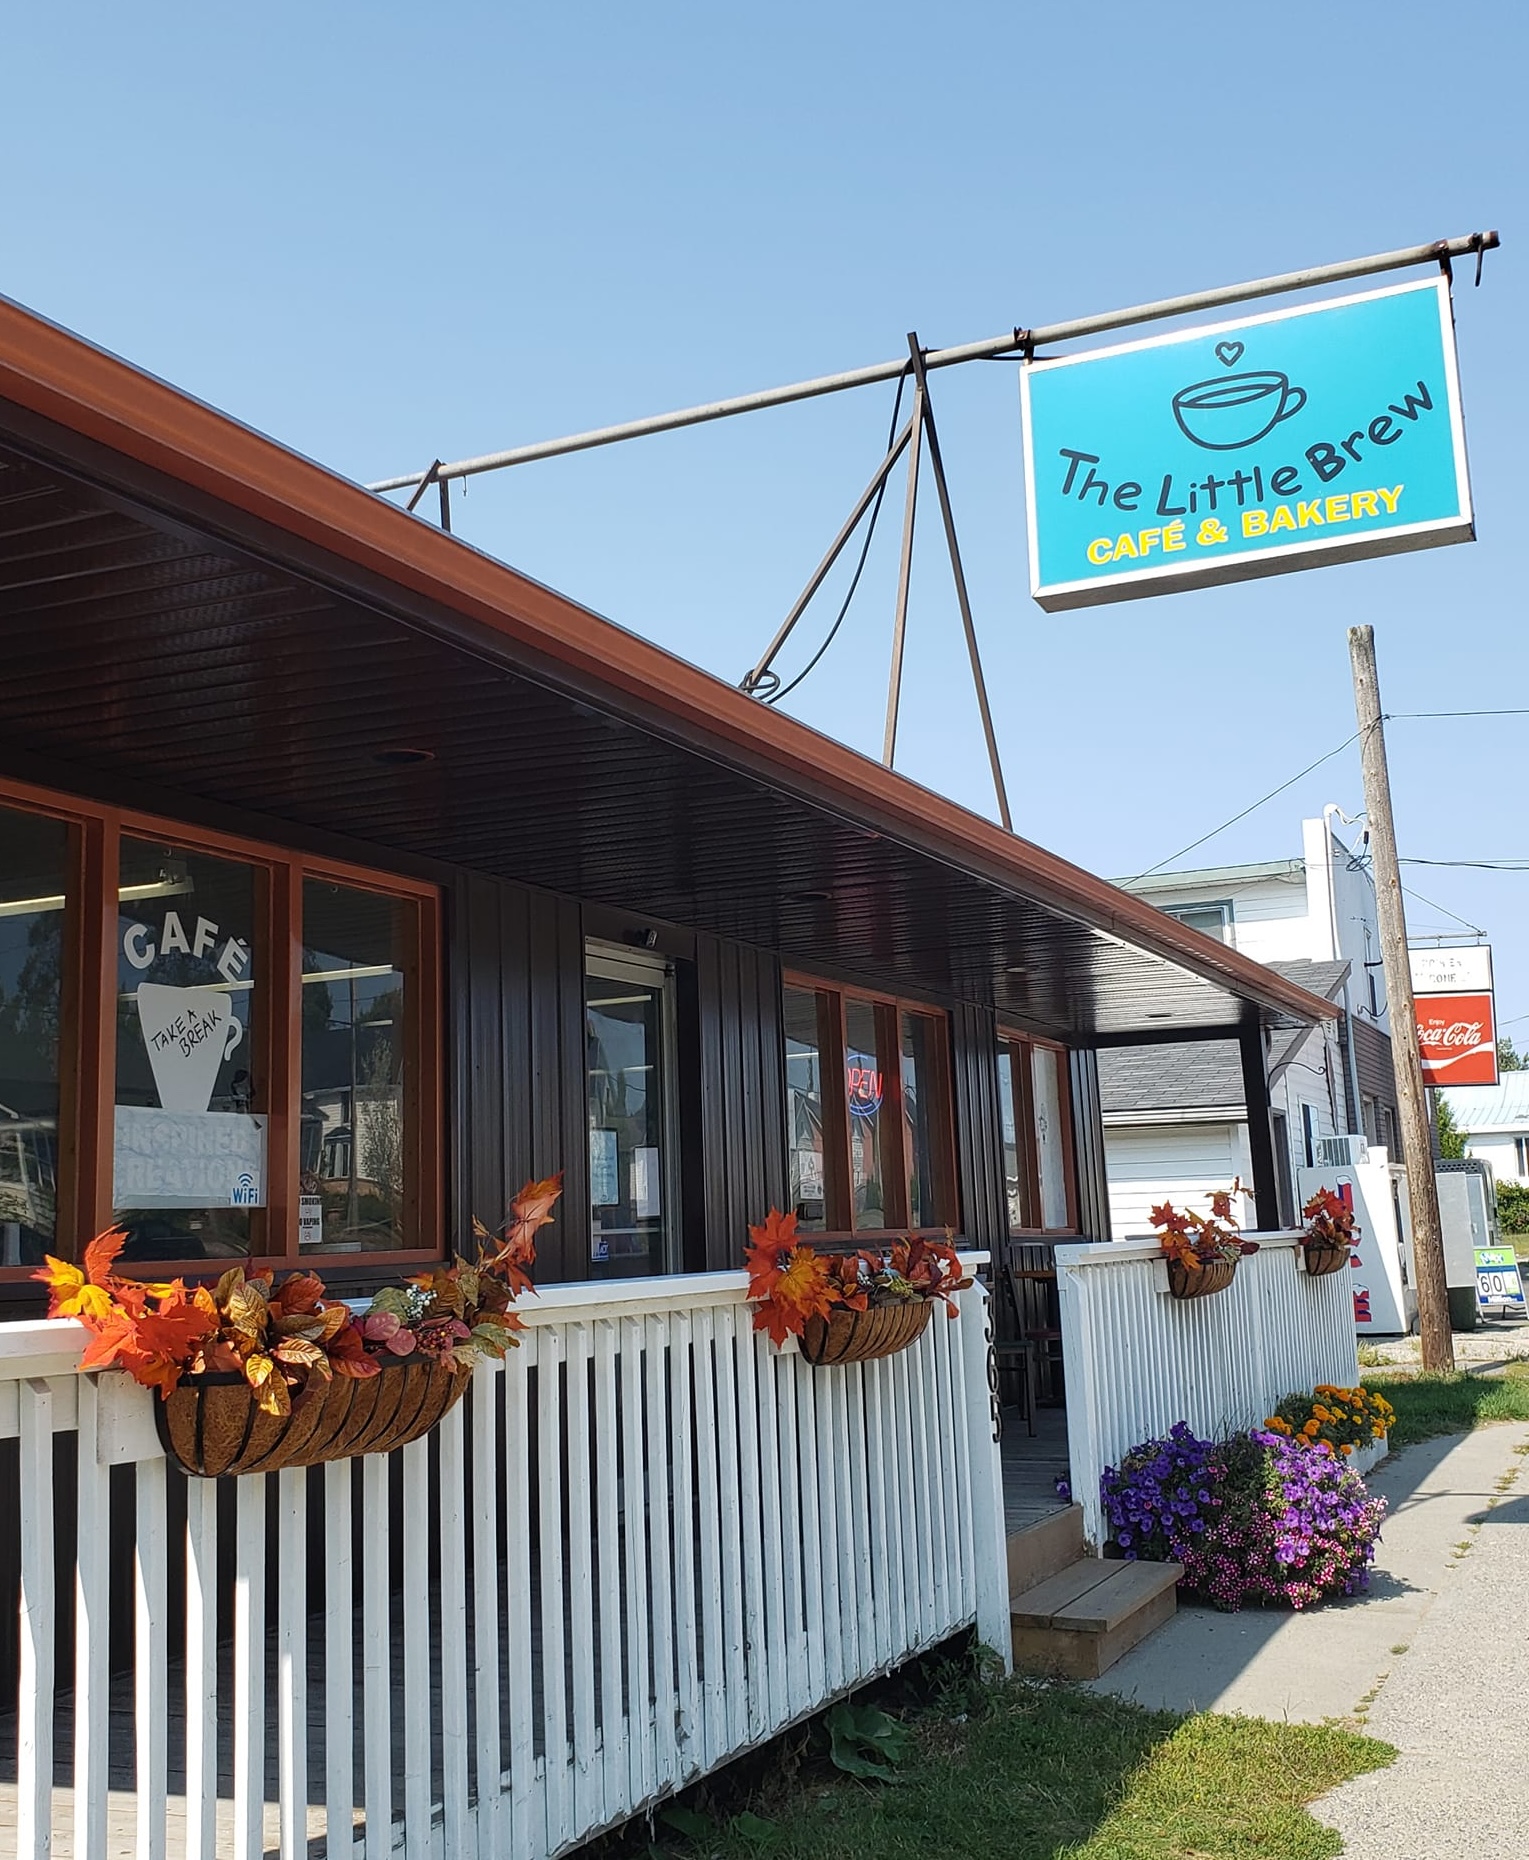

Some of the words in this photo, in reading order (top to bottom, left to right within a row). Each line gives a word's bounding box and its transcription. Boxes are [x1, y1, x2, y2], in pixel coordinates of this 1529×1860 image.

[1059, 448, 1142, 511] The
[1156, 466, 1303, 516] Little
[1305, 380, 1434, 482] Brew
[1087, 518, 1187, 566] CAFÉ
[1196, 516, 1229, 547] &
[1241, 484, 1406, 540] BAKERY
[123, 911, 249, 983] CAFÉ
[151, 1016, 187, 1051] TAKE
[187, 1009, 198, 1023] A
[179, 1009, 222, 1058] BREAK
[1416, 1021, 1484, 1046] oca-Cola
[232, 1187, 258, 1204] WiFi
[982, 1294, 1003, 1444] 365
